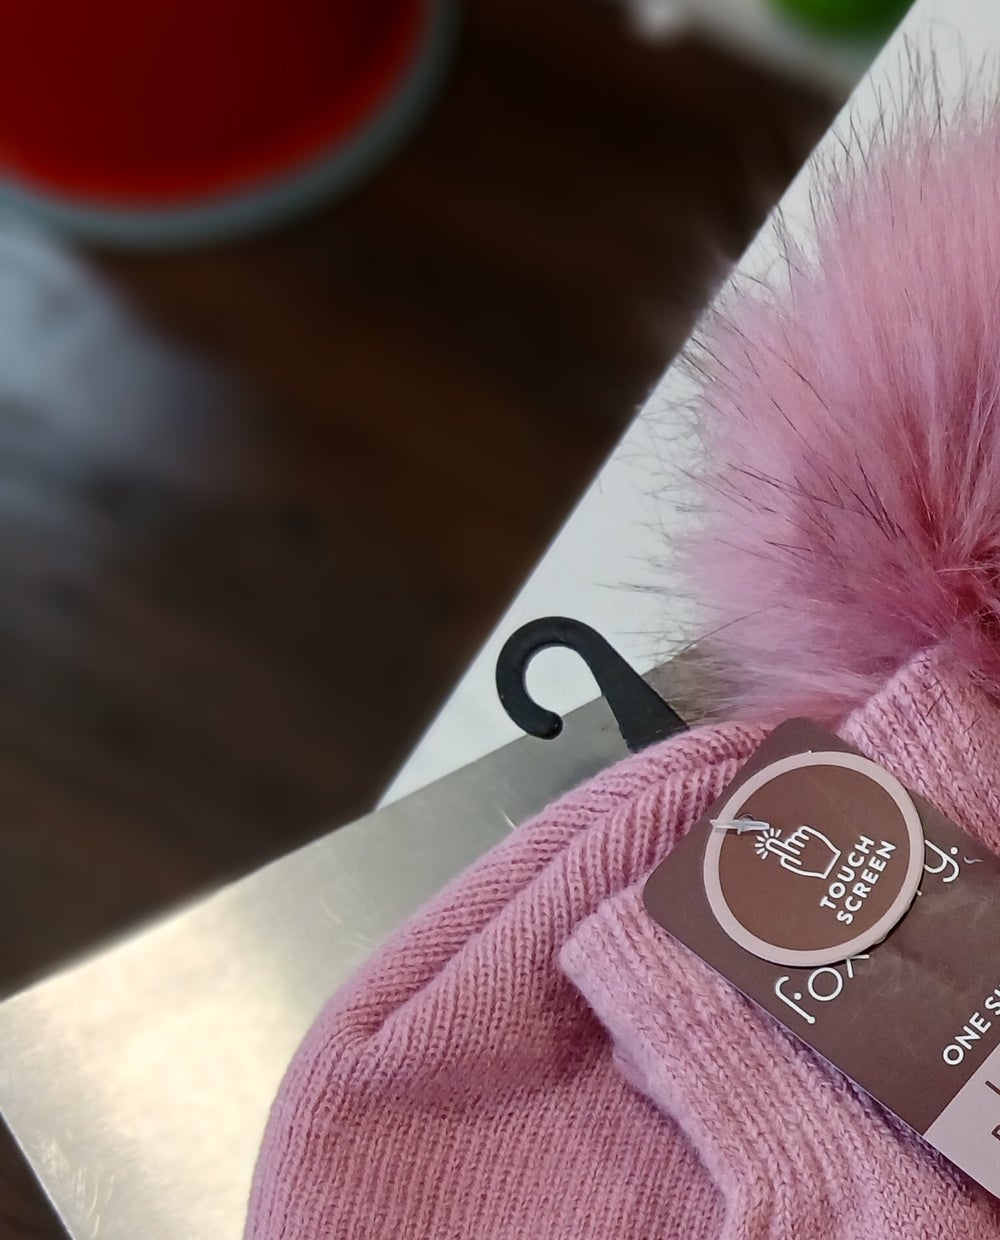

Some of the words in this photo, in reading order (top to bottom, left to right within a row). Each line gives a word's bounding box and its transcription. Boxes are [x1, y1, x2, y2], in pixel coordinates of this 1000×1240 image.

[820, 835, 875, 909] TOUCH
[836, 840, 896, 925] SCREEN
[943, 1012, 992, 1065] ONE
